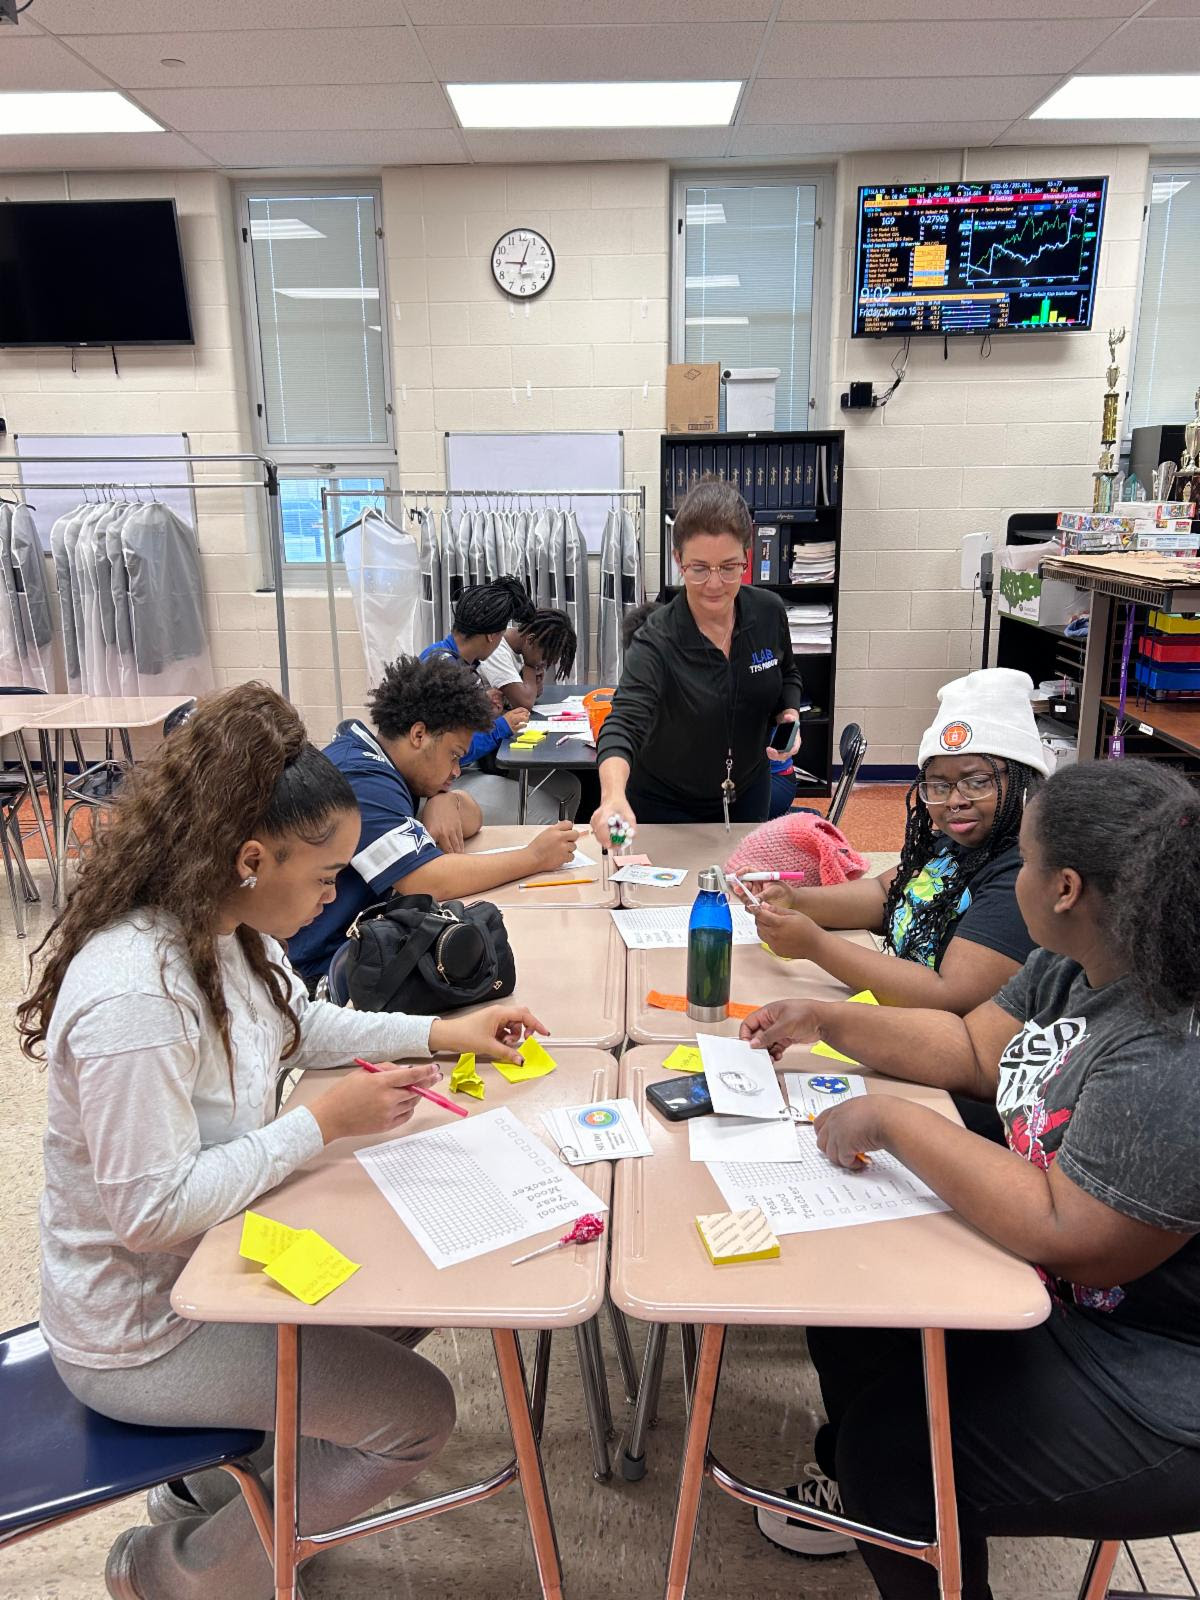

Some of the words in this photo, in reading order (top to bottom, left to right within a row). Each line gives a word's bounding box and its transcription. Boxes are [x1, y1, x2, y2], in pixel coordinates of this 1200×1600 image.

[508, 236, 515, 246] 11
[519, 232, 528, 242] 12
[498, 246, 506, 255] 10
[540, 247, 546, 255] 2
[496, 259, 501, 267] 9
[499, 271, 504, 279] 8
[541, 272, 546, 280] 4
[509, 282, 514, 290] 7
[520, 285, 525, 293] 6
[531, 282, 537, 290] 5
[860, 286, 892, 302] 9:02
[860, 308, 881, 318] Friday,
[884, 307, 907, 316] March
[512, 1176, 562, 1197] Tracker
[527, 1186, 561, 1201] Mood
[536, 1194, 568, 1208] Year
[762, 1196, 780, 1216] Year
[776, 1193, 797, 1215] Mood
[788, 1186, 815, 1220] Tracker
[537, 1200, 579, 1219] School
